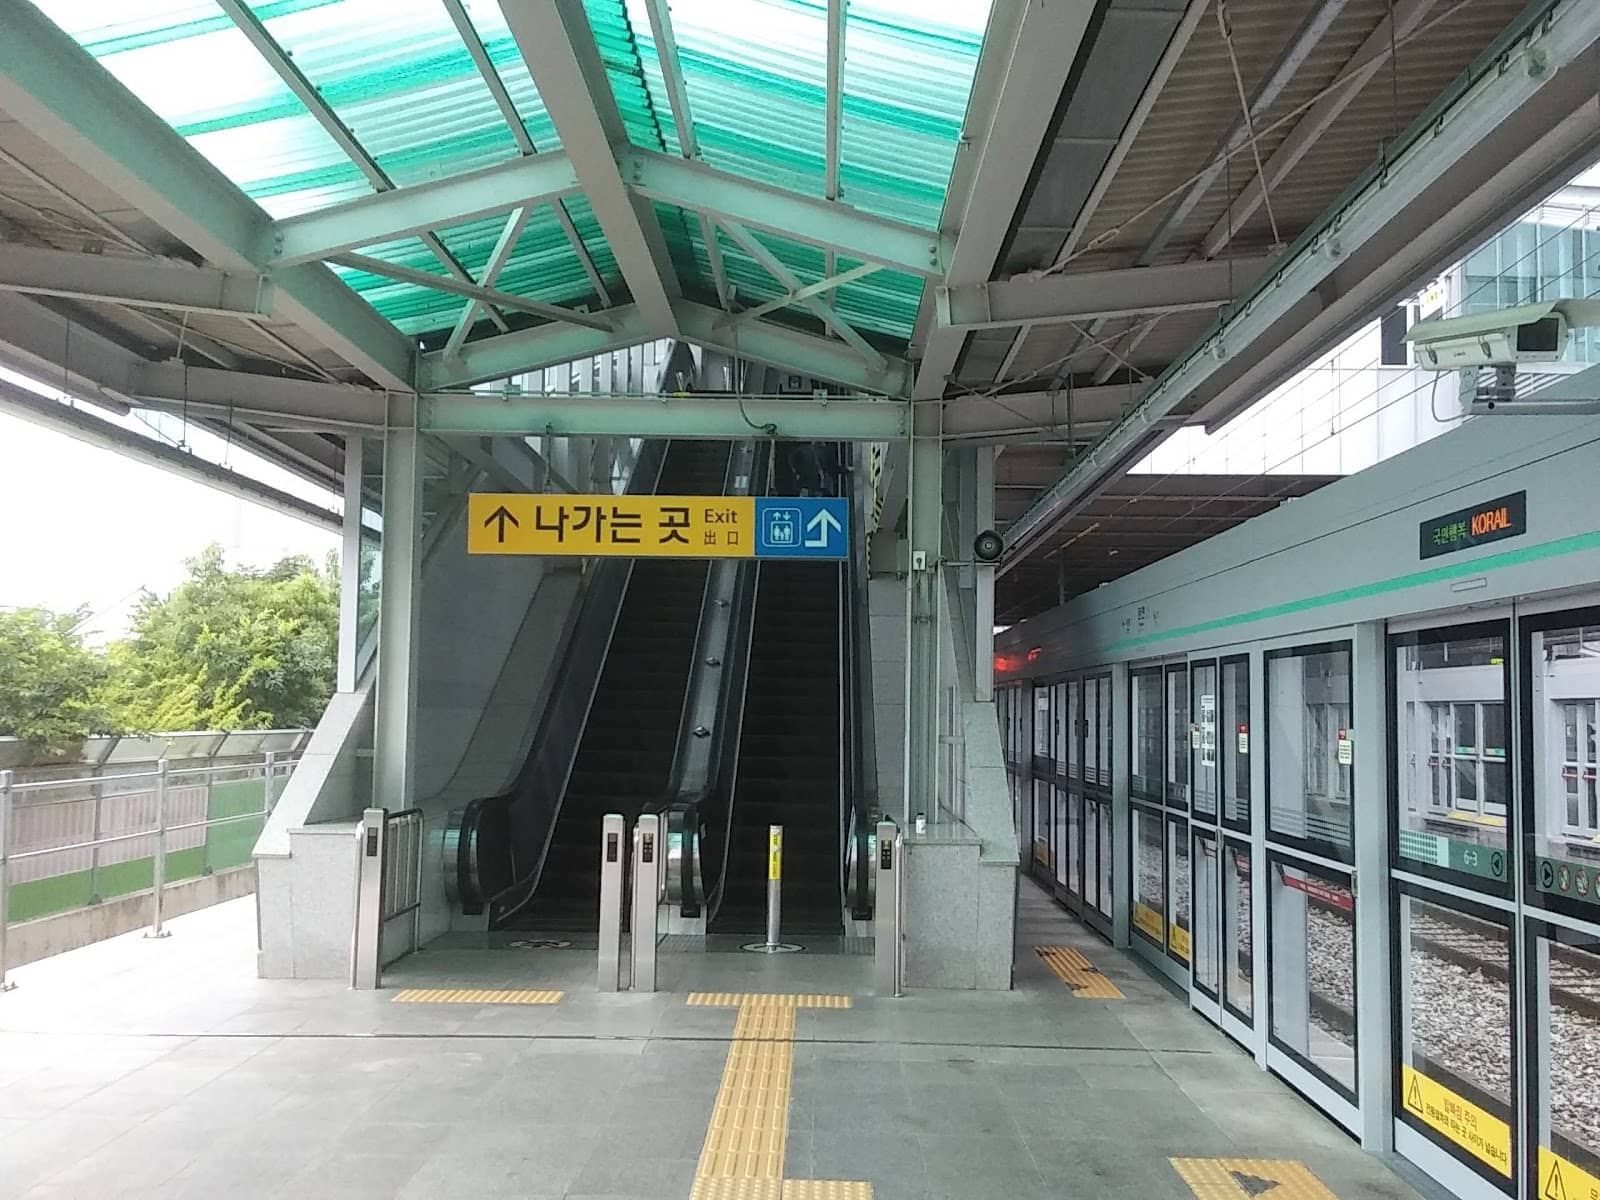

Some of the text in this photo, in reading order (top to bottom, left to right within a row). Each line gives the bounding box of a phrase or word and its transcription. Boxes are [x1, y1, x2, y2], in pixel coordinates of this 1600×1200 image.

[535, 505, 690, 544] 나가는 곳
[704, 508, 737, 524] Exit
[1432, 507, 1512, 546] 국민행복 KORAIL
[1463, 850, 1478, 866] 6-3
[1464, 1110, 1478, 1131] 주의
